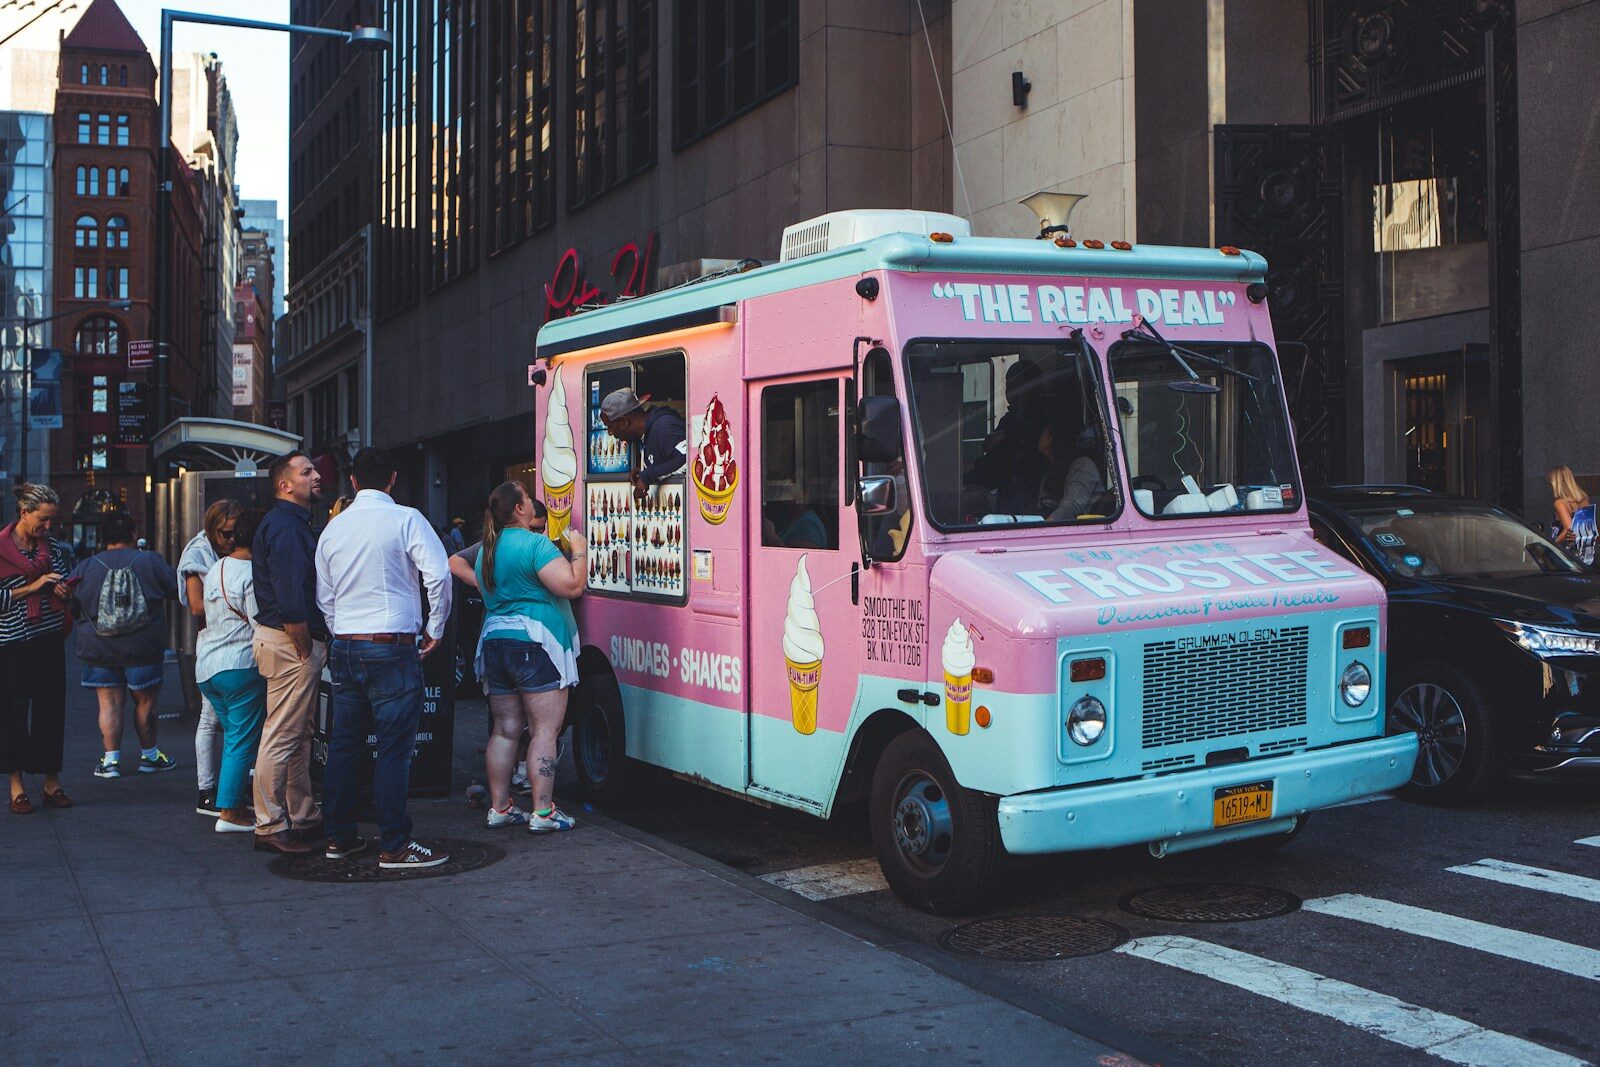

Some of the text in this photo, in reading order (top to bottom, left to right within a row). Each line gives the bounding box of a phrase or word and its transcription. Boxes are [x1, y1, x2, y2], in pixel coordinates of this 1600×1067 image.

[1037, 285, 1133, 323] REAL
[1014, 550, 1357, 604] FROSTEE
[863, 596, 924, 621] SMOOTHIE INC.
[1097, 603, 1200, 625] Delicious
[1271, 588, 1340, 608] Treats
[862, 618, 876, 638] 328
[915, 623, 928, 644] ST.
[1177, 628, 1278, 650] GRUMMAN OLSON
[610, 635, 741, 694] SUNDAES SHAKES
[867, 640, 922, 667] BK. N.Y. 11206
[789, 667, 818, 685] FUN-TIME
[424, 686, 441, 698] ALE
[423, 701, 437, 713] 30
[415, 732, 433, 741] ARDEN
